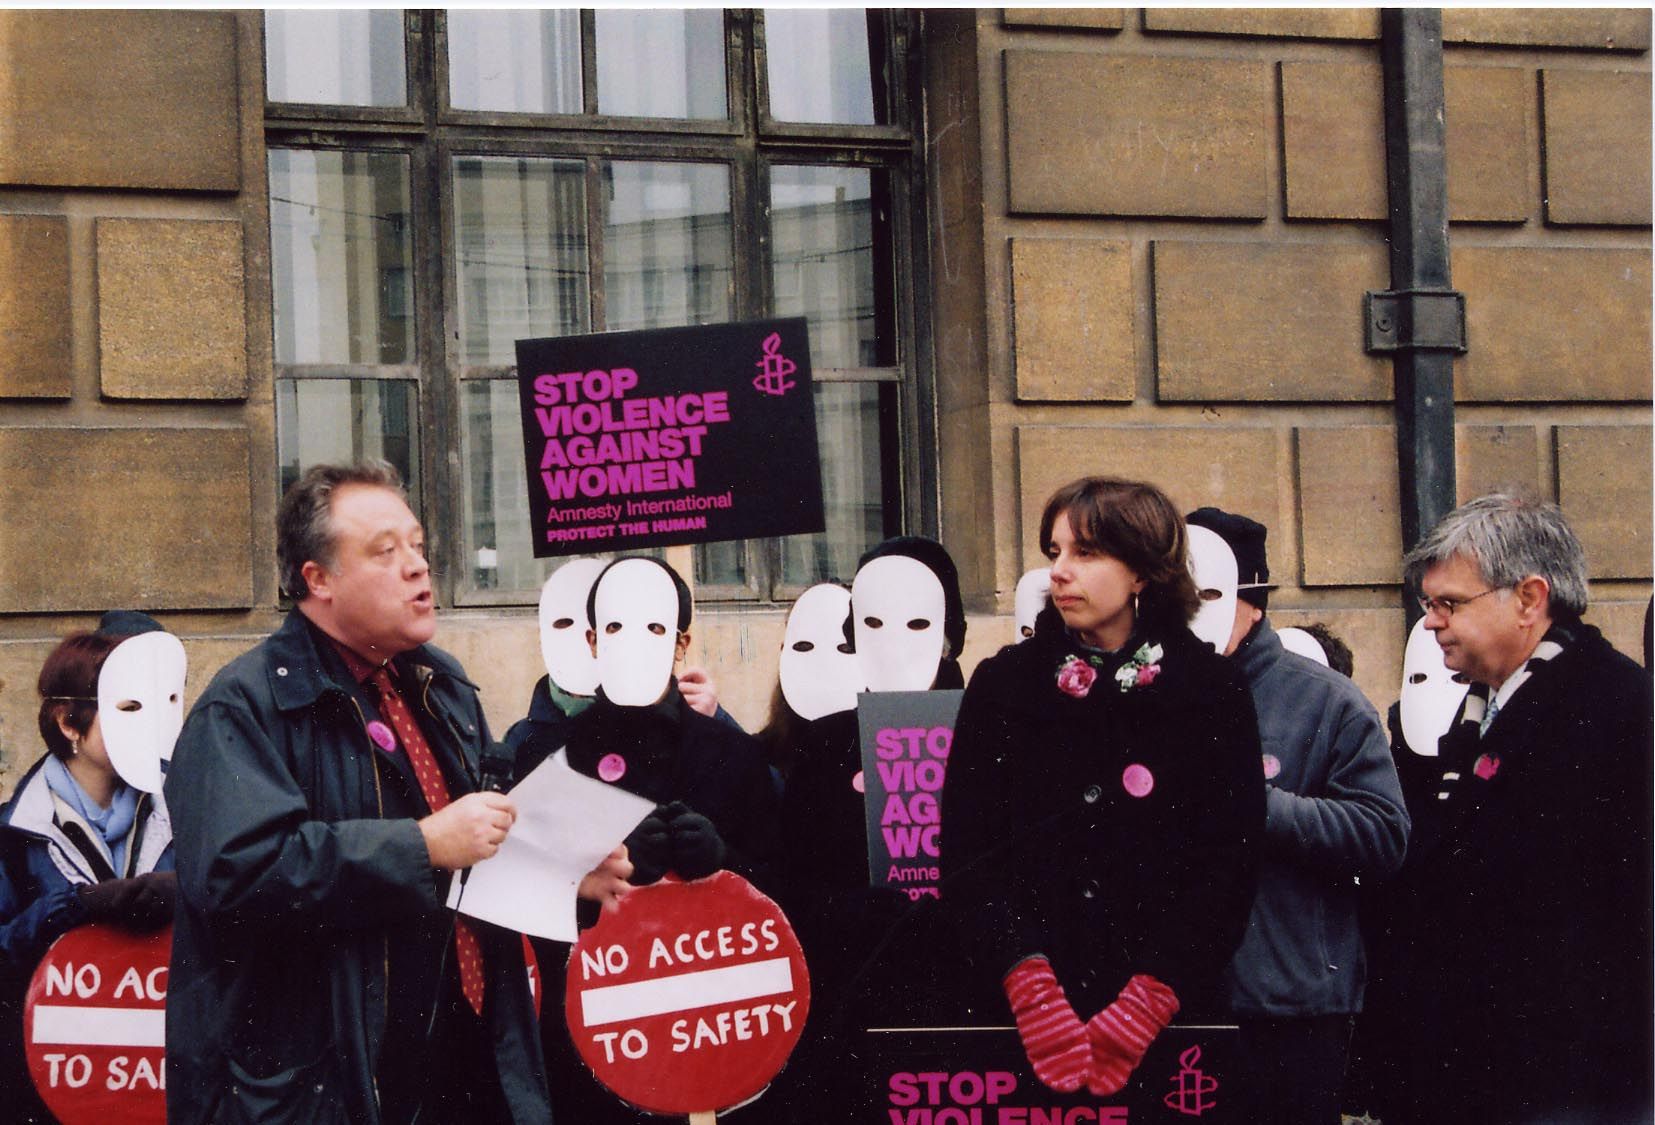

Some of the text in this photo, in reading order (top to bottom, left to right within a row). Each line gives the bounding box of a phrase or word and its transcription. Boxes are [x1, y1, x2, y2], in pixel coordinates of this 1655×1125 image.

[533, 367, 639, 405] STOP
[534, 391, 730, 437] VIOLENCE
[540, 425, 708, 470] AGAINST
[541, 459, 696, 500] WOMEN
[547, 491, 733, 523] Amnesty International
[547, 516, 708, 542] PROTECT THE HUMAN
[887, 864, 940, 882] Amne
[580, 919, 780, 981] NO ACCESS
[45, 961, 169, 1001] NO AC
[592, 1000, 797, 1064] TO SAFETY
[43, 1053, 92, 1089] TO
[888, 1071, 1018, 1106] STOP
